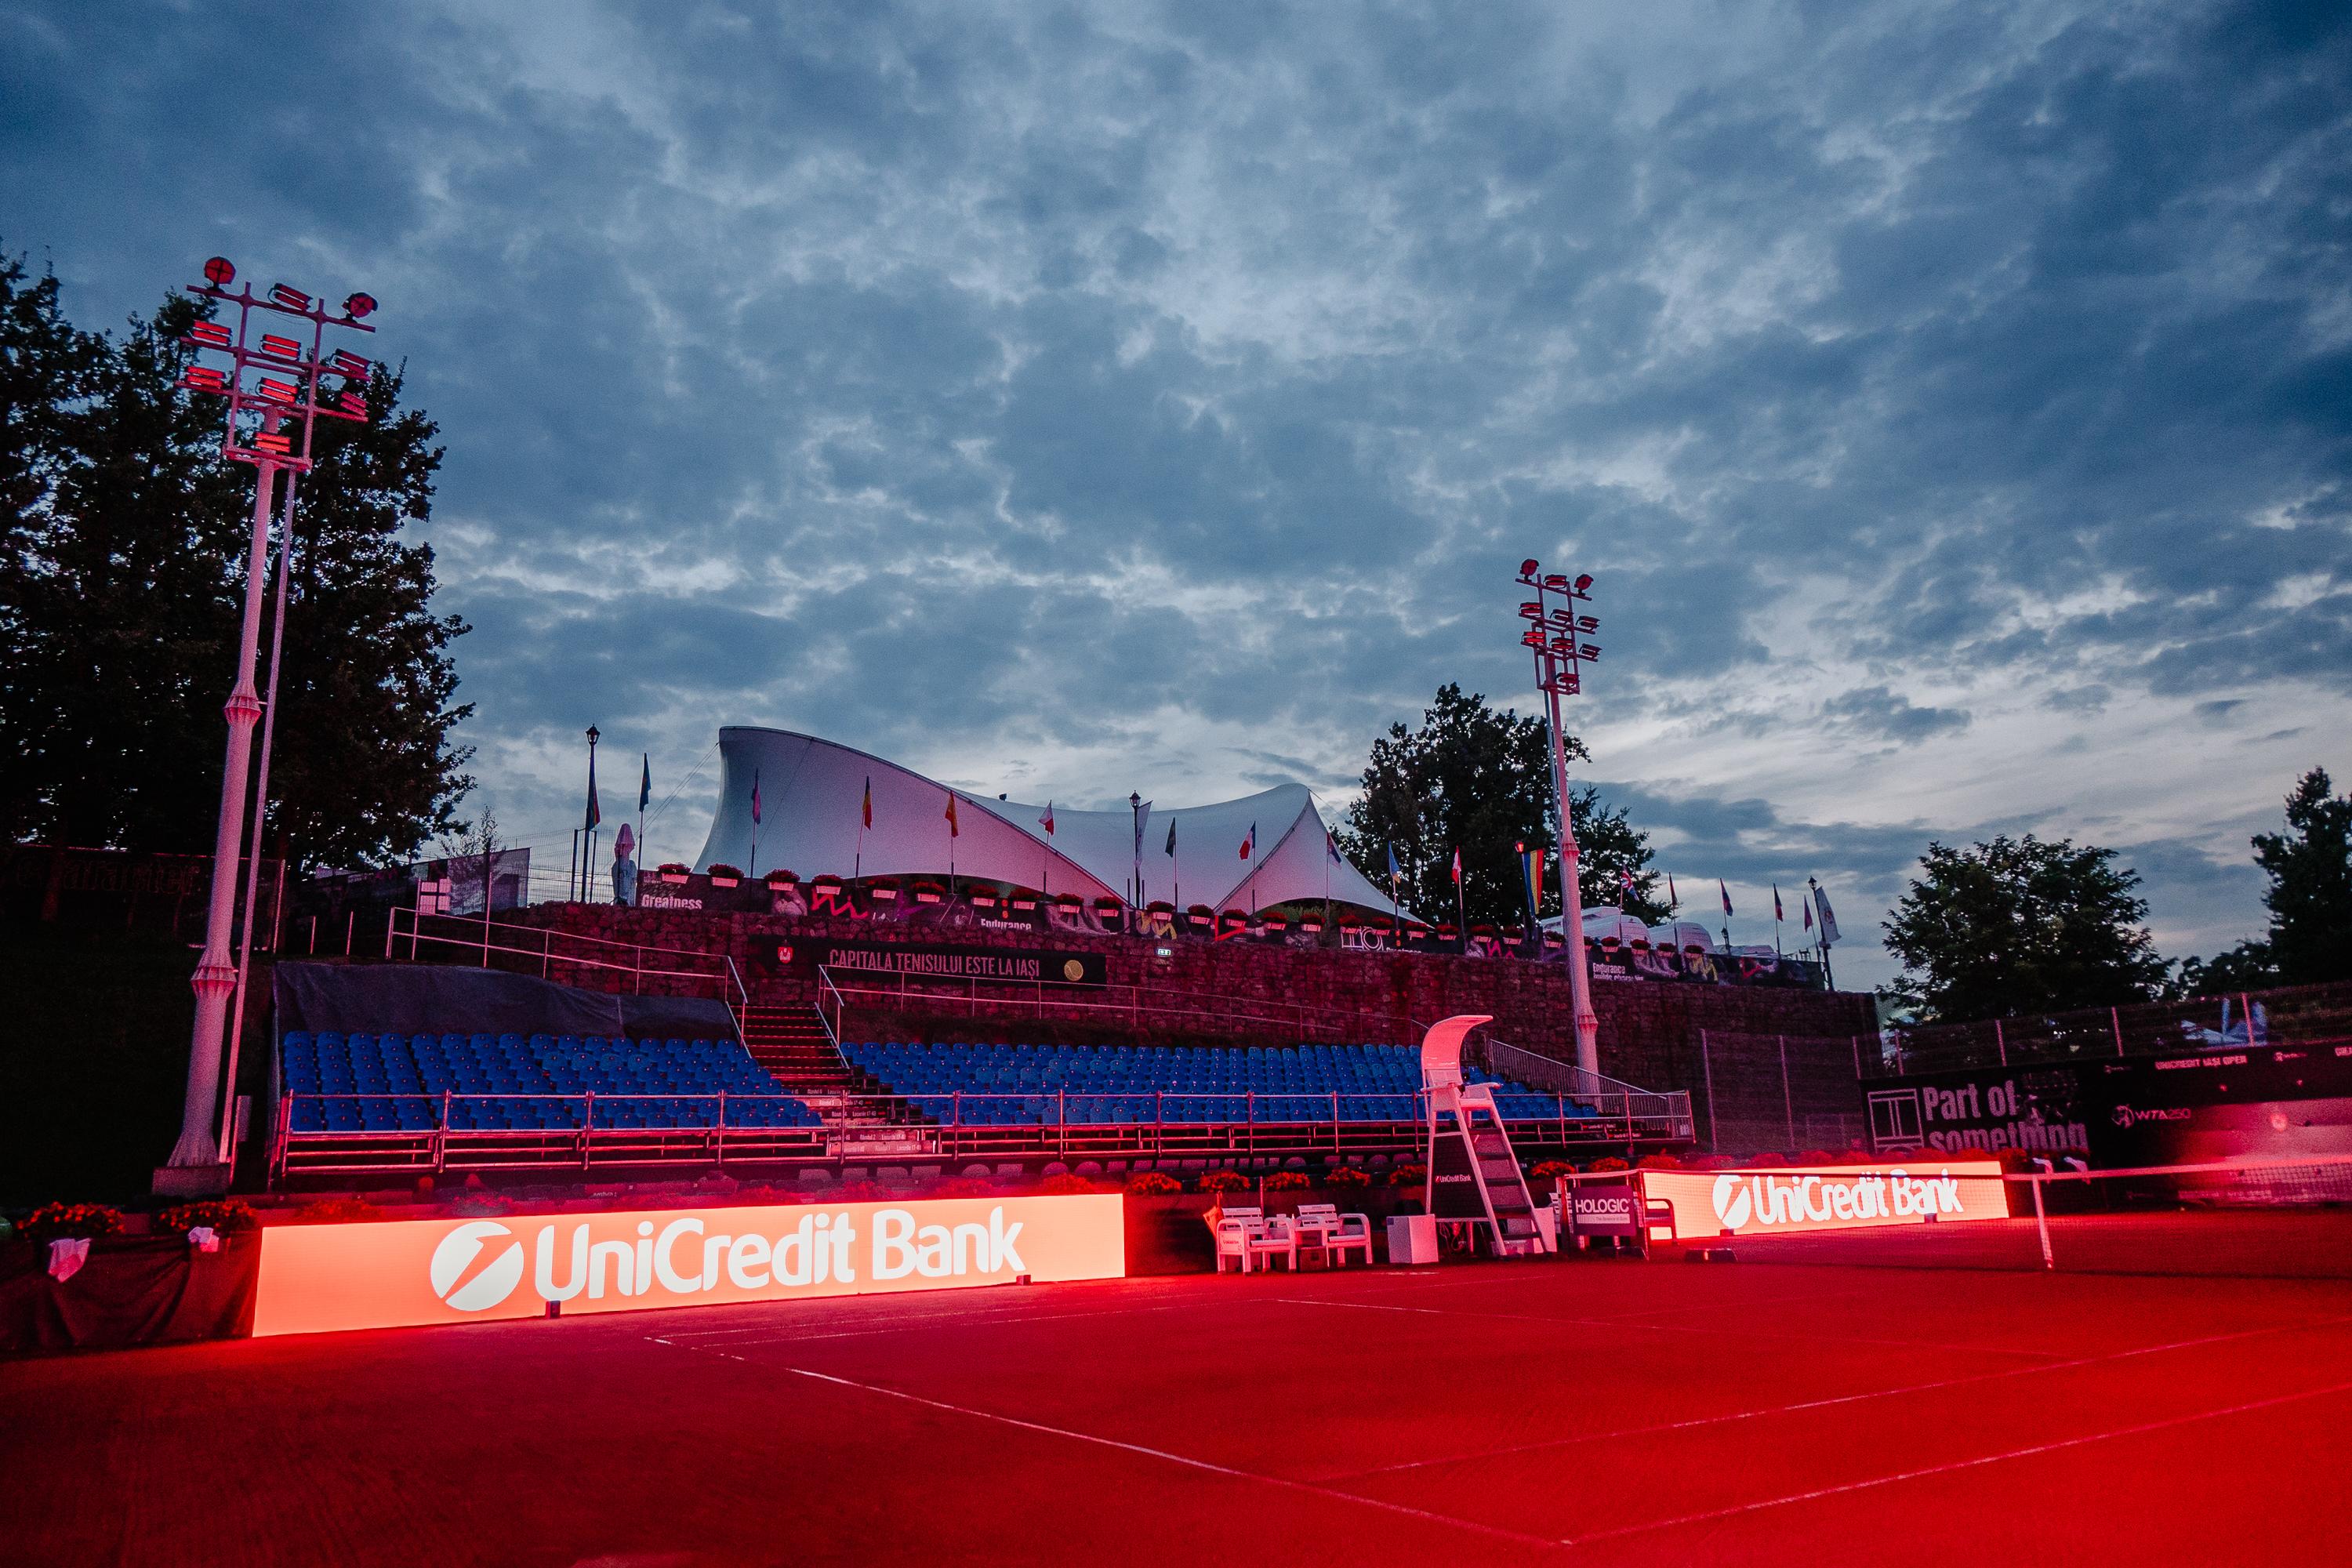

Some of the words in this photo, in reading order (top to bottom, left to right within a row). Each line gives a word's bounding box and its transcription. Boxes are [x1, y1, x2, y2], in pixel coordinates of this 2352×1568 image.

[641, 894, 703, 910] Greatness
[980, 917, 1033, 931] Endurance
[829, 949, 893, 971] CAPITALA
[895, 953, 963, 974] TENISULUI
[966, 956, 996, 975] ESTE
[998, 958, 1014, 976] LA
[1592, 962, 1626, 975] Endurance
[1922, 1083, 1982, 1121] Part
[1987, 1079, 2019, 1117] of
[1460, 1174, 1472, 1182] Bank
[1752, 1169, 1891, 1225] UniCredit
[1890, 1169, 1964, 1215] Bank
[1575, 1198, 1630, 1214] HOLOGIC
[535, 1212, 856, 1301] UniCredit
[873, 1206, 1026, 1279] Bank
